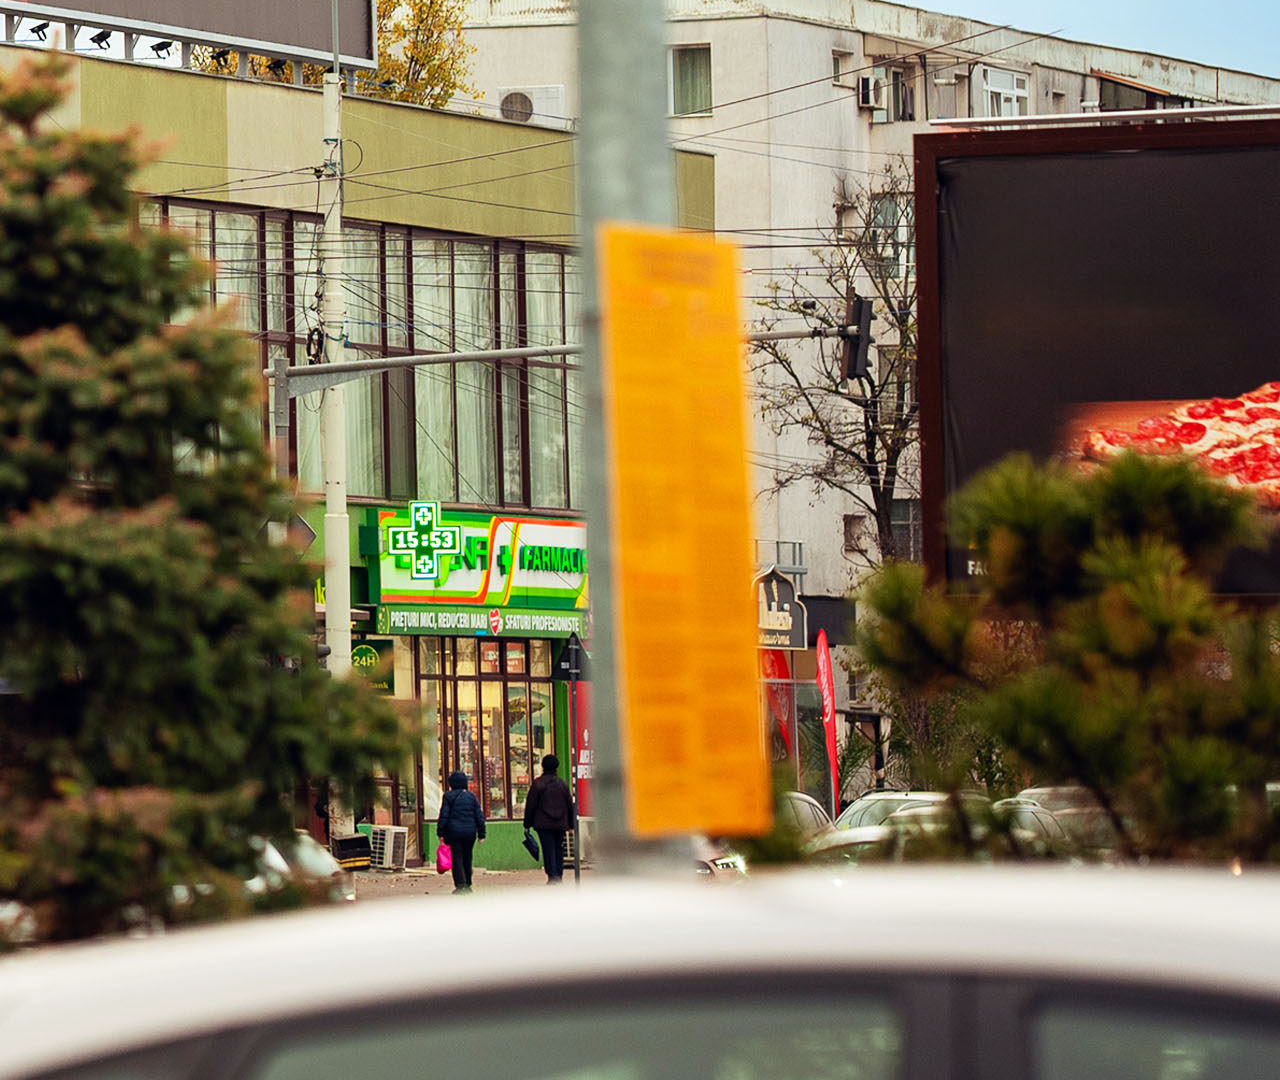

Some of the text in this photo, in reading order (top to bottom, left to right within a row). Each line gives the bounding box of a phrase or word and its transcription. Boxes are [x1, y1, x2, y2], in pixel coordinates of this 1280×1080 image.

[395, 531, 453, 548] 15:53
[420, 612, 437, 628] MICI,
[438, 613, 469, 628] REDUCERI
[470, 613, 487, 629] MARI
[505, 614, 531, 630] SFATURI
[531, 615, 579, 633] PROFESIONISTE
[353, 655, 376, 667] 24H
